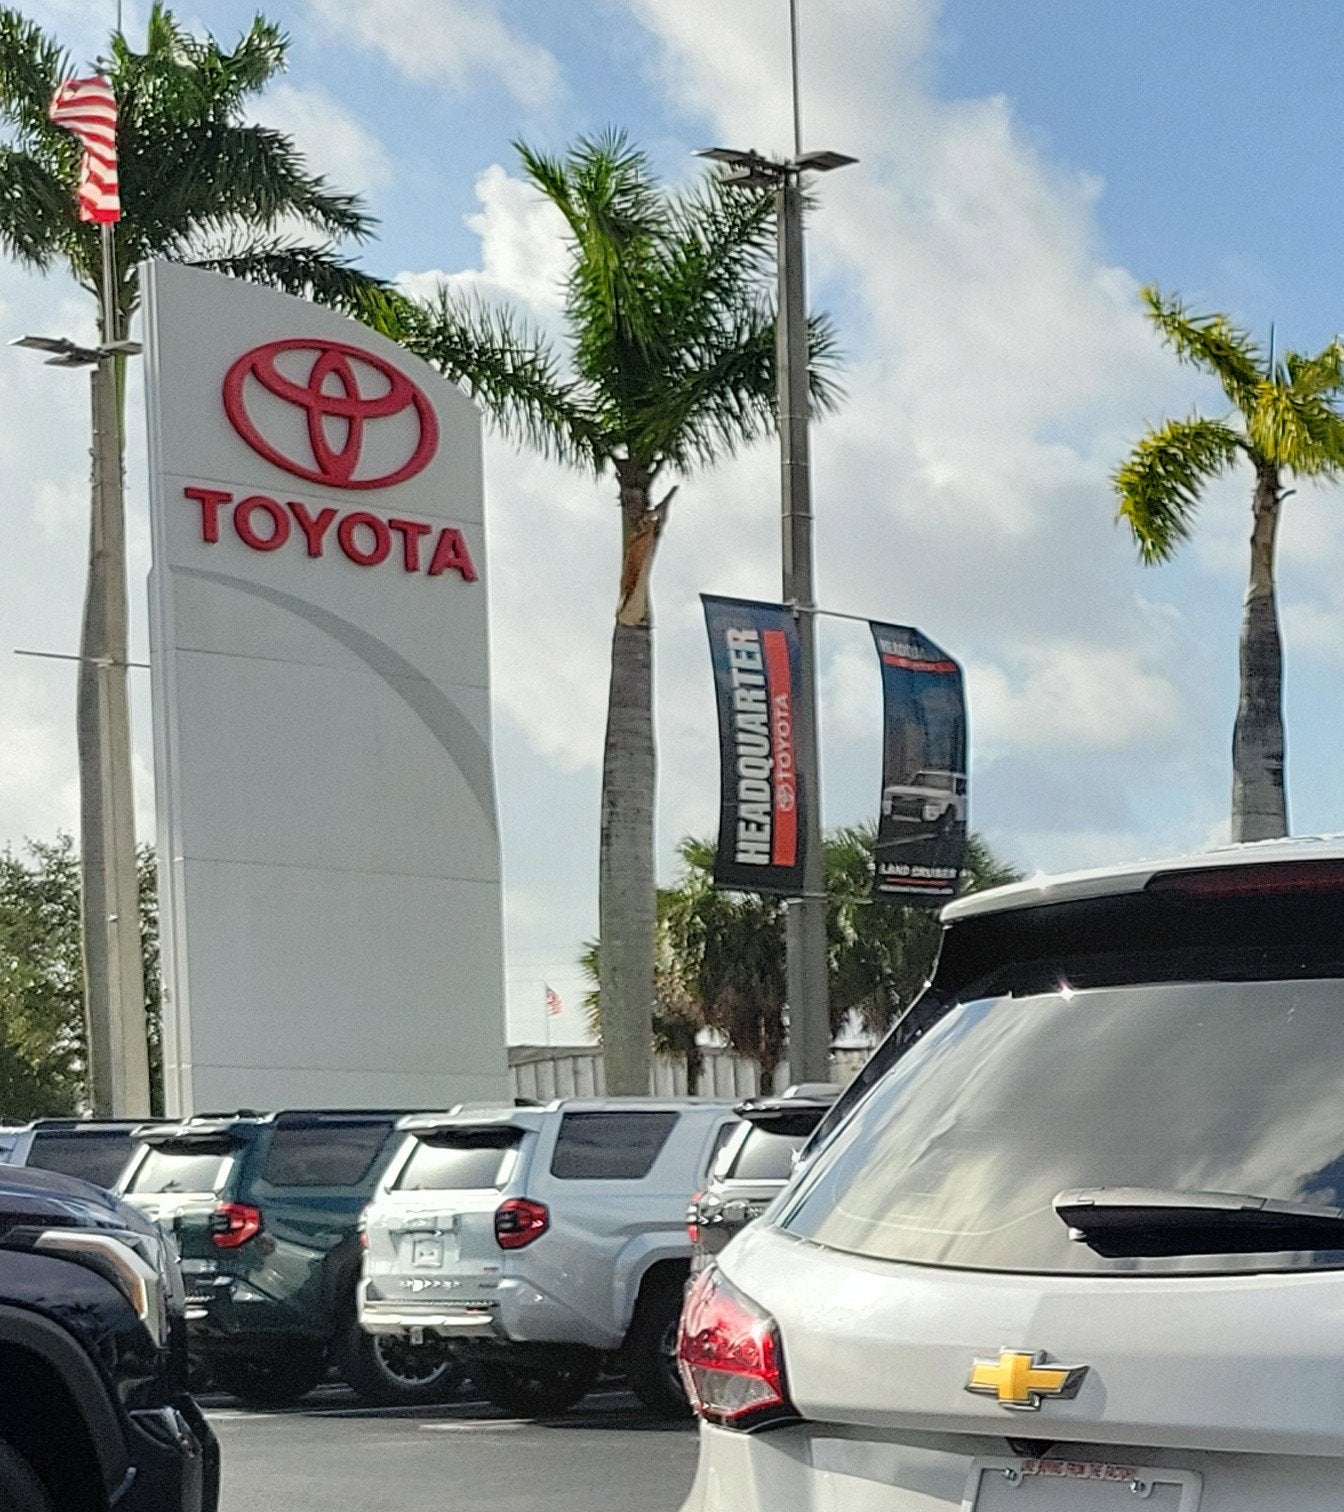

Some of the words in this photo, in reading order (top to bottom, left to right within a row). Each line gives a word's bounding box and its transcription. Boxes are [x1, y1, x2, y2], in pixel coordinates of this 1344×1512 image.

[184, 487, 479, 582] TOYOTA
[726, 628, 775, 866] HEADQUARTER
[776, 694, 791, 780] TOYOTA
